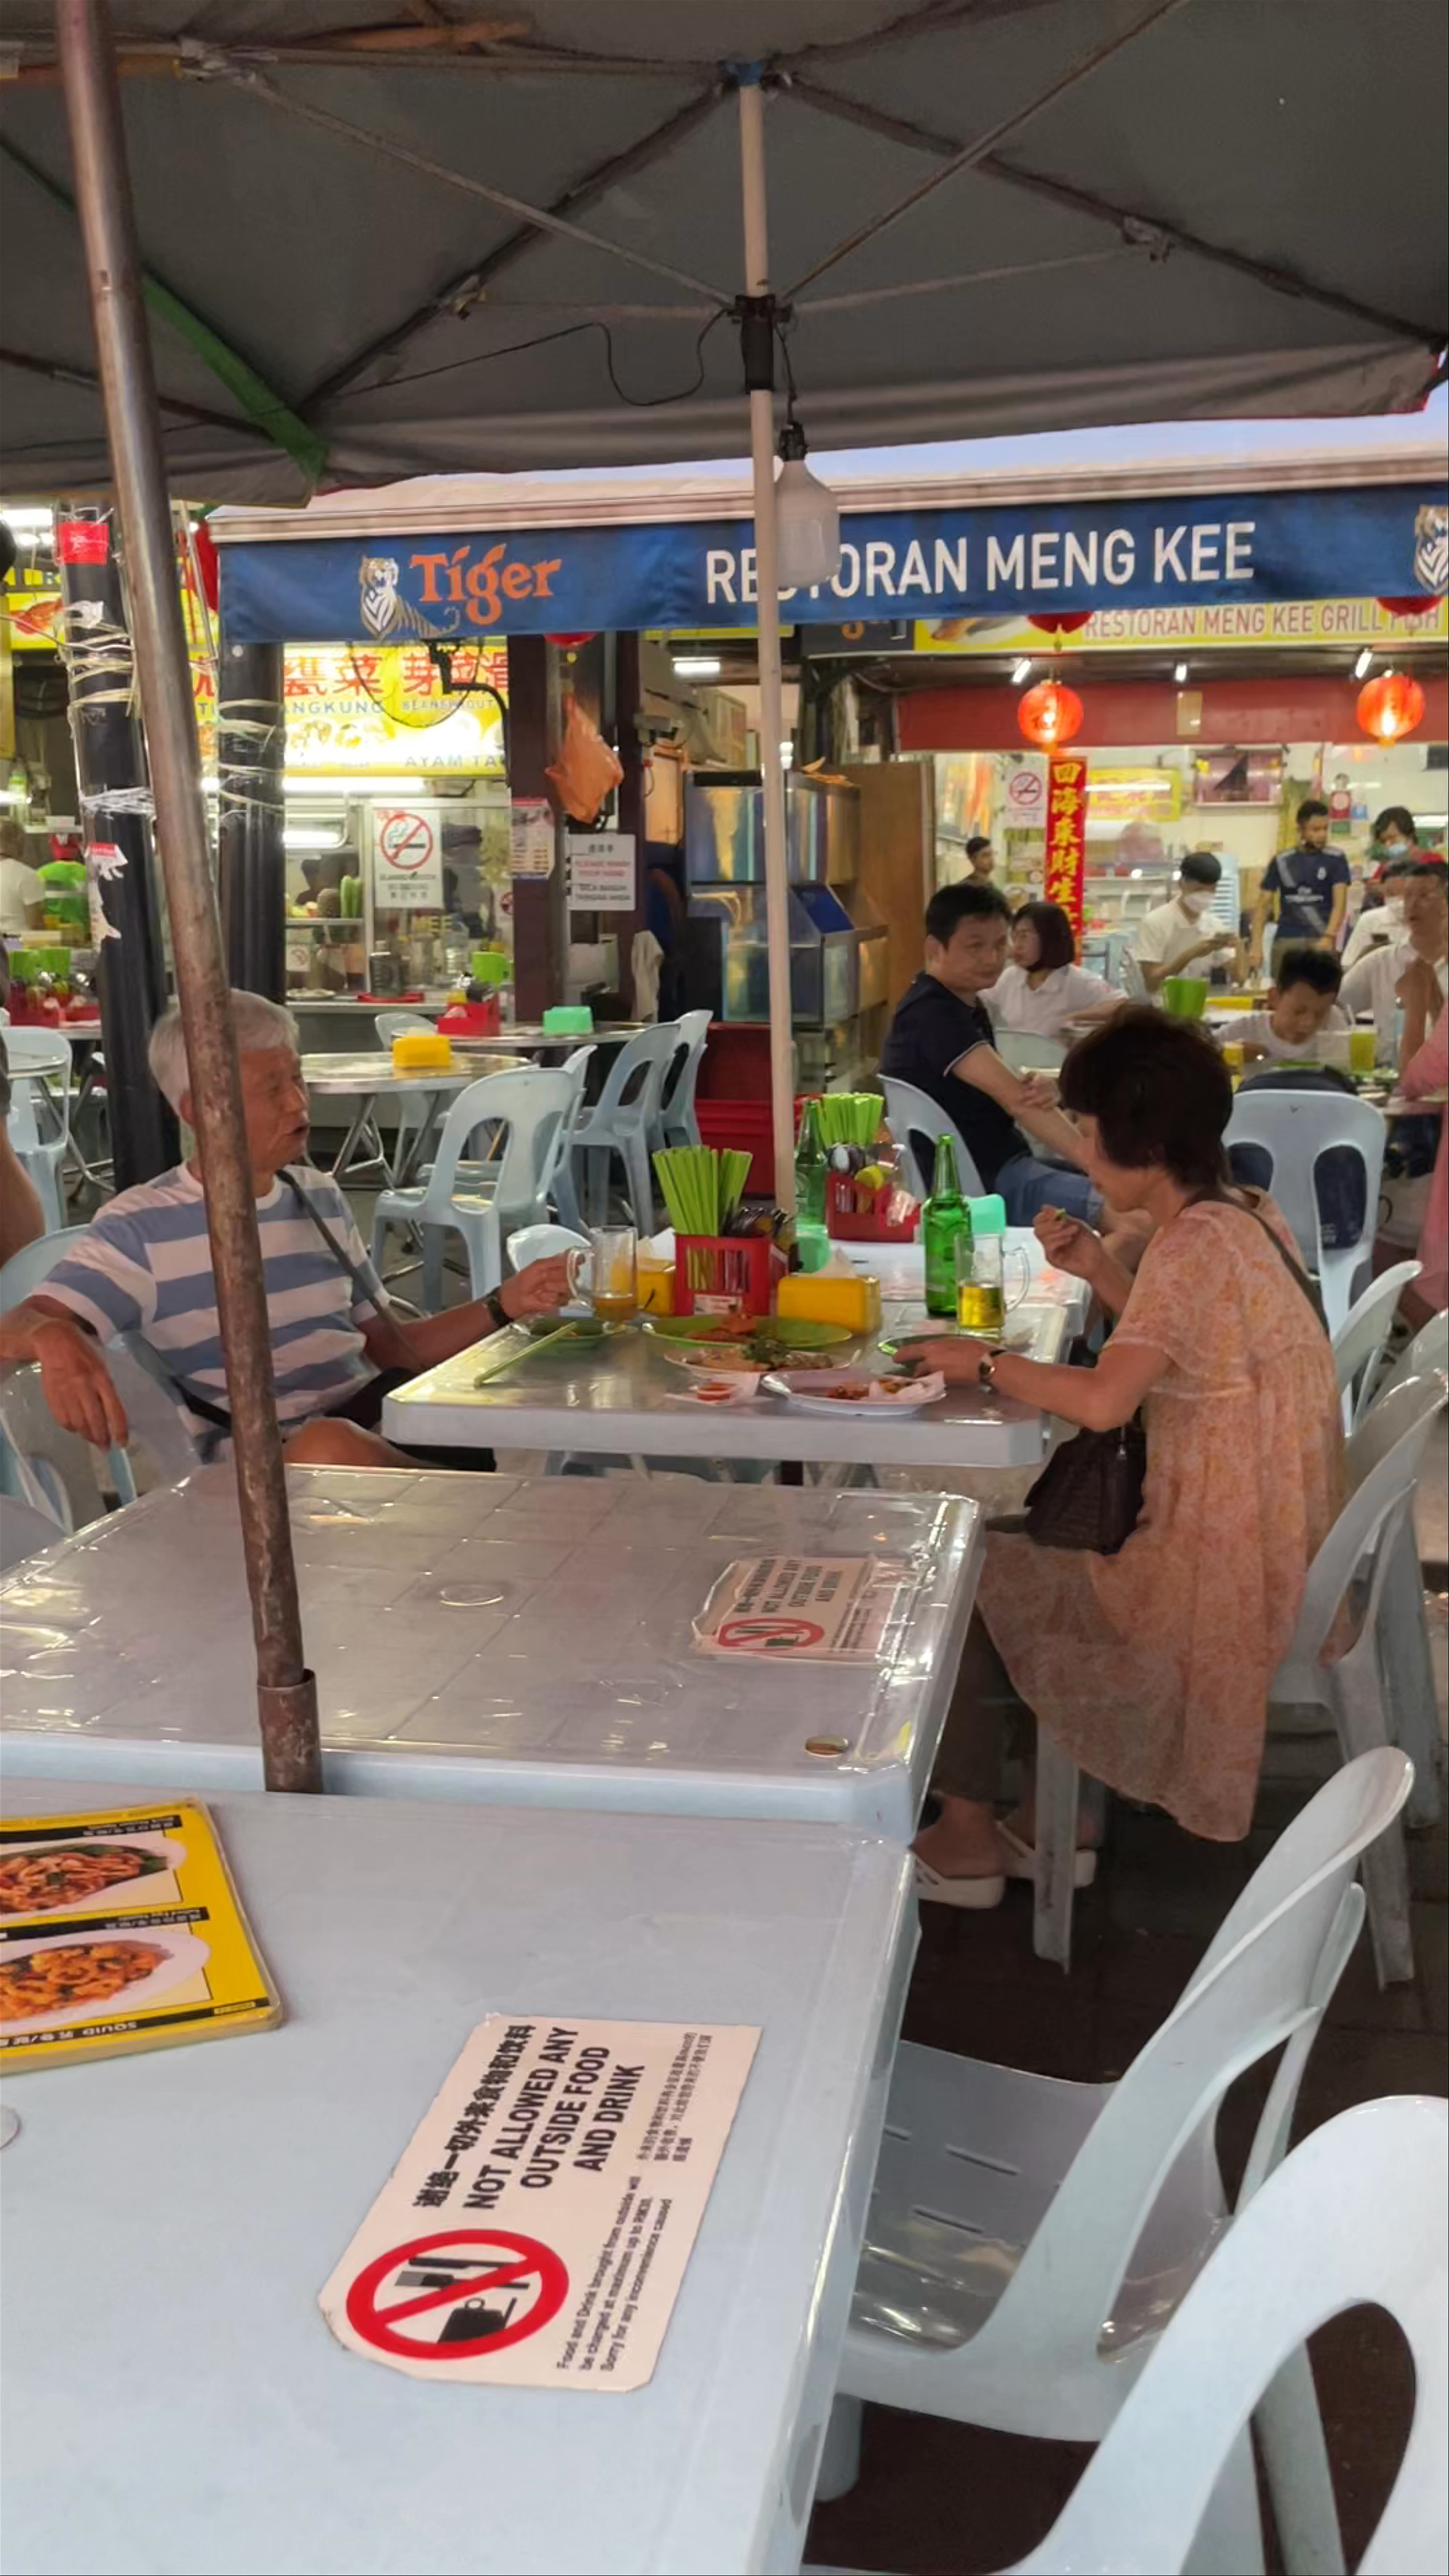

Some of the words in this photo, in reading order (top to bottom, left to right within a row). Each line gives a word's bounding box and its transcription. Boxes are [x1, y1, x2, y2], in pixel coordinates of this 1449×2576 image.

[706, 538, 967, 604] REORAN
[986, 528, 1135, 591] MENG
[1153, 521, 1256, 583] KEE
[409, 543, 561, 625] Tiger
[1084, 609, 1195, 638] RESTORAN
[1204, 607, 1265, 634] MENG
[1273, 605, 1314, 633] KEE
[1321, 604, 1383, 632] GRILL
[405, 755, 463, 767] AYAM
[83, 2022, 137, 2036] SQUID
[594, 2066, 643, 2122] DRINK
[464, 2165, 511, 2209] NOT
[492, 2069, 558, 2159] ALLOWED
[539, 2027, 577, 2063] ANY
[521, 2101, 586, 2188] OUTSIDE
[563, 2047, 609, 2095] FOOD
[574, 2129, 616, 2171] AND
[629, 2177, 640, 2190] will
[616, 2193, 635, 2225] outside
[654, 2199, 672, 2231] caused
[603, 2227, 621, 2248] from
[627, 2236, 640, 2248] up
[629, 2225, 643, 2235] to
[589, 2250, 613, 2288] brought
[609, 2251, 632, 2297] maximum
[629, 2233, 660, 2301] inconvenience
[576, 2291, 597, 2317] Drink
[604, 2299, 615, 2310] at
[621, 2304, 638, 2322] any
[571, 2319, 586, 2339] and
[588, 2312, 611, 2354] charged
[611, 2324, 628, 2339] for
[556, 2341, 578, 2368] Food
[580, 2357, 594, 2370] be
[600, 2342, 625, 2371] Sorry
